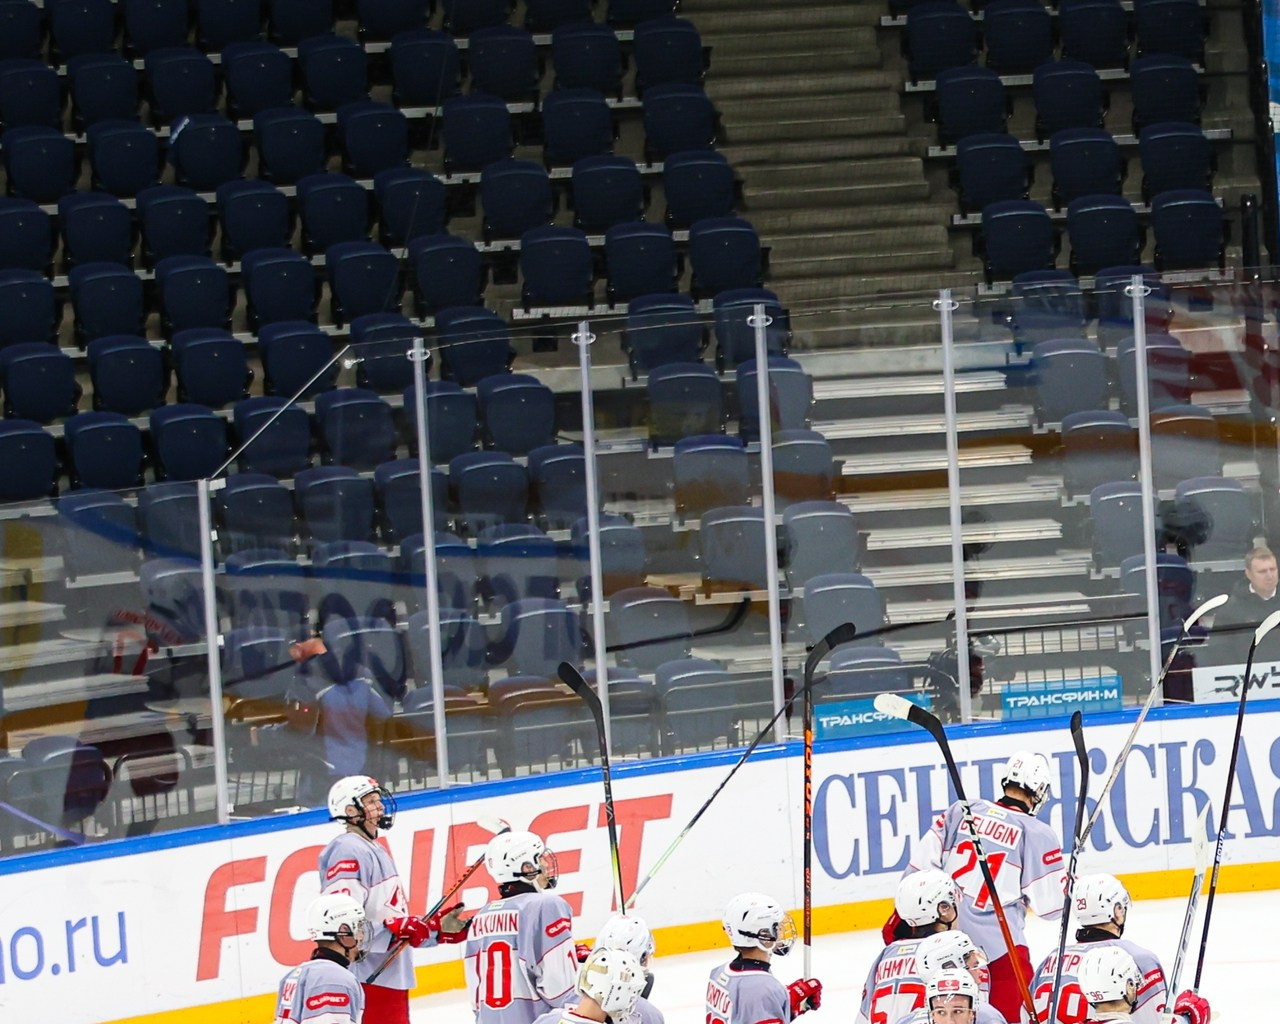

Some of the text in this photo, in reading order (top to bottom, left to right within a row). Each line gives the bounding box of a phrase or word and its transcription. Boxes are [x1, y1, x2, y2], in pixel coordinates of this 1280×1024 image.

[1077, 899, 1087, 910] 29
[472, 912, 518, 937] YAKUNIN
[0, 911, 128, 984] o.ru
[1090, 991, 1104, 1001] 96
